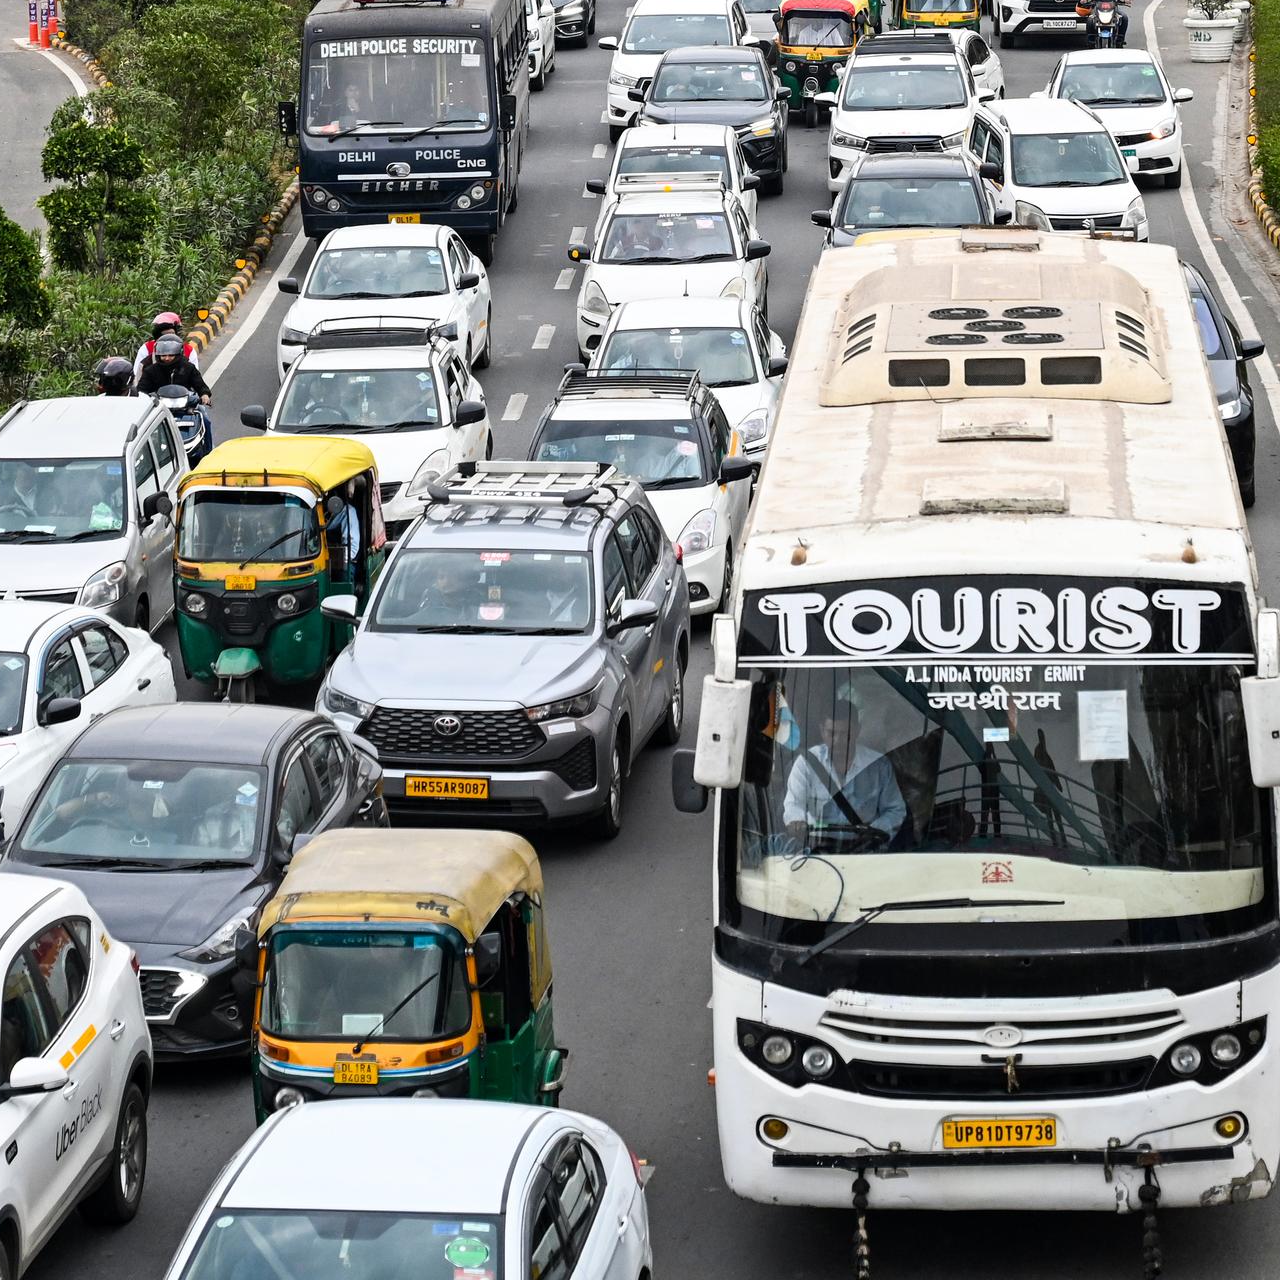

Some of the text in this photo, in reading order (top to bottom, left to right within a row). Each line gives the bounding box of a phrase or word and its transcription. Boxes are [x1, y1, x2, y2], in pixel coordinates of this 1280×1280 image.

[320, 38, 477, 58] DELHI POLICE SECURITY
[338, 149, 462, 163] DELHI POLICE
[457, 159, 487, 168] CNG
[361, 180, 440, 193] EICHER
[757, 586, 1222, 658] TOURIST
[973, 666, 1033, 682] TOURIST
[413, 780, 488, 795] HR55AR9087
[341, 1074, 372, 1083] B4089
[55, 1082, 103, 1161] Uber Black
[953, 1124, 1054, 1143] UP81DT9738
